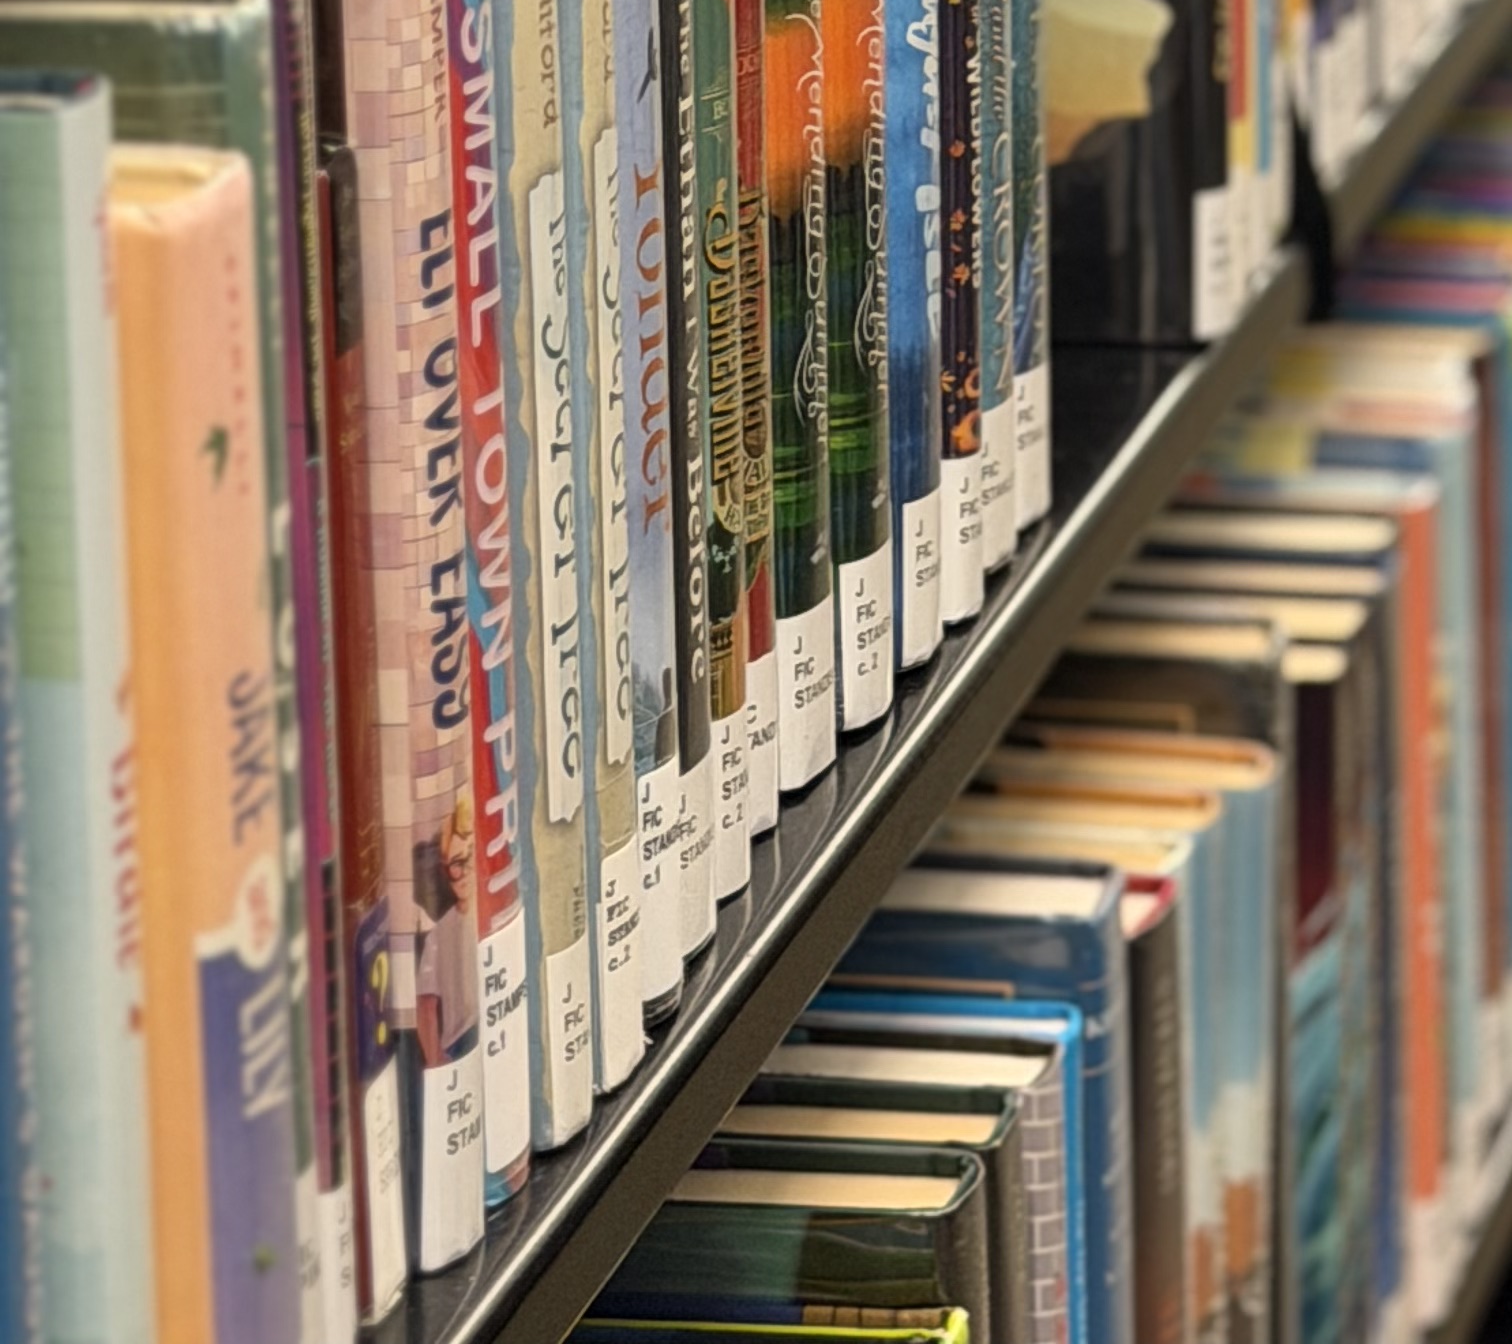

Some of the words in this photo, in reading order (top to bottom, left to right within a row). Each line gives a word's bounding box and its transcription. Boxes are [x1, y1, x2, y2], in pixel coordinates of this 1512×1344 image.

[458, 3, 502, 350] SMALL
[678, 94, 699, 303] Ethan
[418, 208, 452, 309] ELI
[423, 337, 462, 530] OVER
[959, 476, 970, 495] J
[472, 384, 514, 673] TOWN
[914, 518, 923, 538] J
[687, 453, 707, 684] Before
[854, 577, 865, 598] J
[856, 599, 878, 625] FIC
[430, 555, 470, 731] EASY
[793, 634, 803, 656] J
[794, 656, 816, 683] FIC
[721, 724, 730, 745] J
[721, 746, 743, 773] FIC
[641, 781, 651, 805] J
[678, 793, 687, 815] J
[642, 804, 664, 833] FIC
[483, 944, 494, 968] J
[484, 966, 507, 998] FIC
[561, 981, 573, 1004] J
[446, 1068, 458, 1092] J
[446, 1092, 473, 1124] FIC
